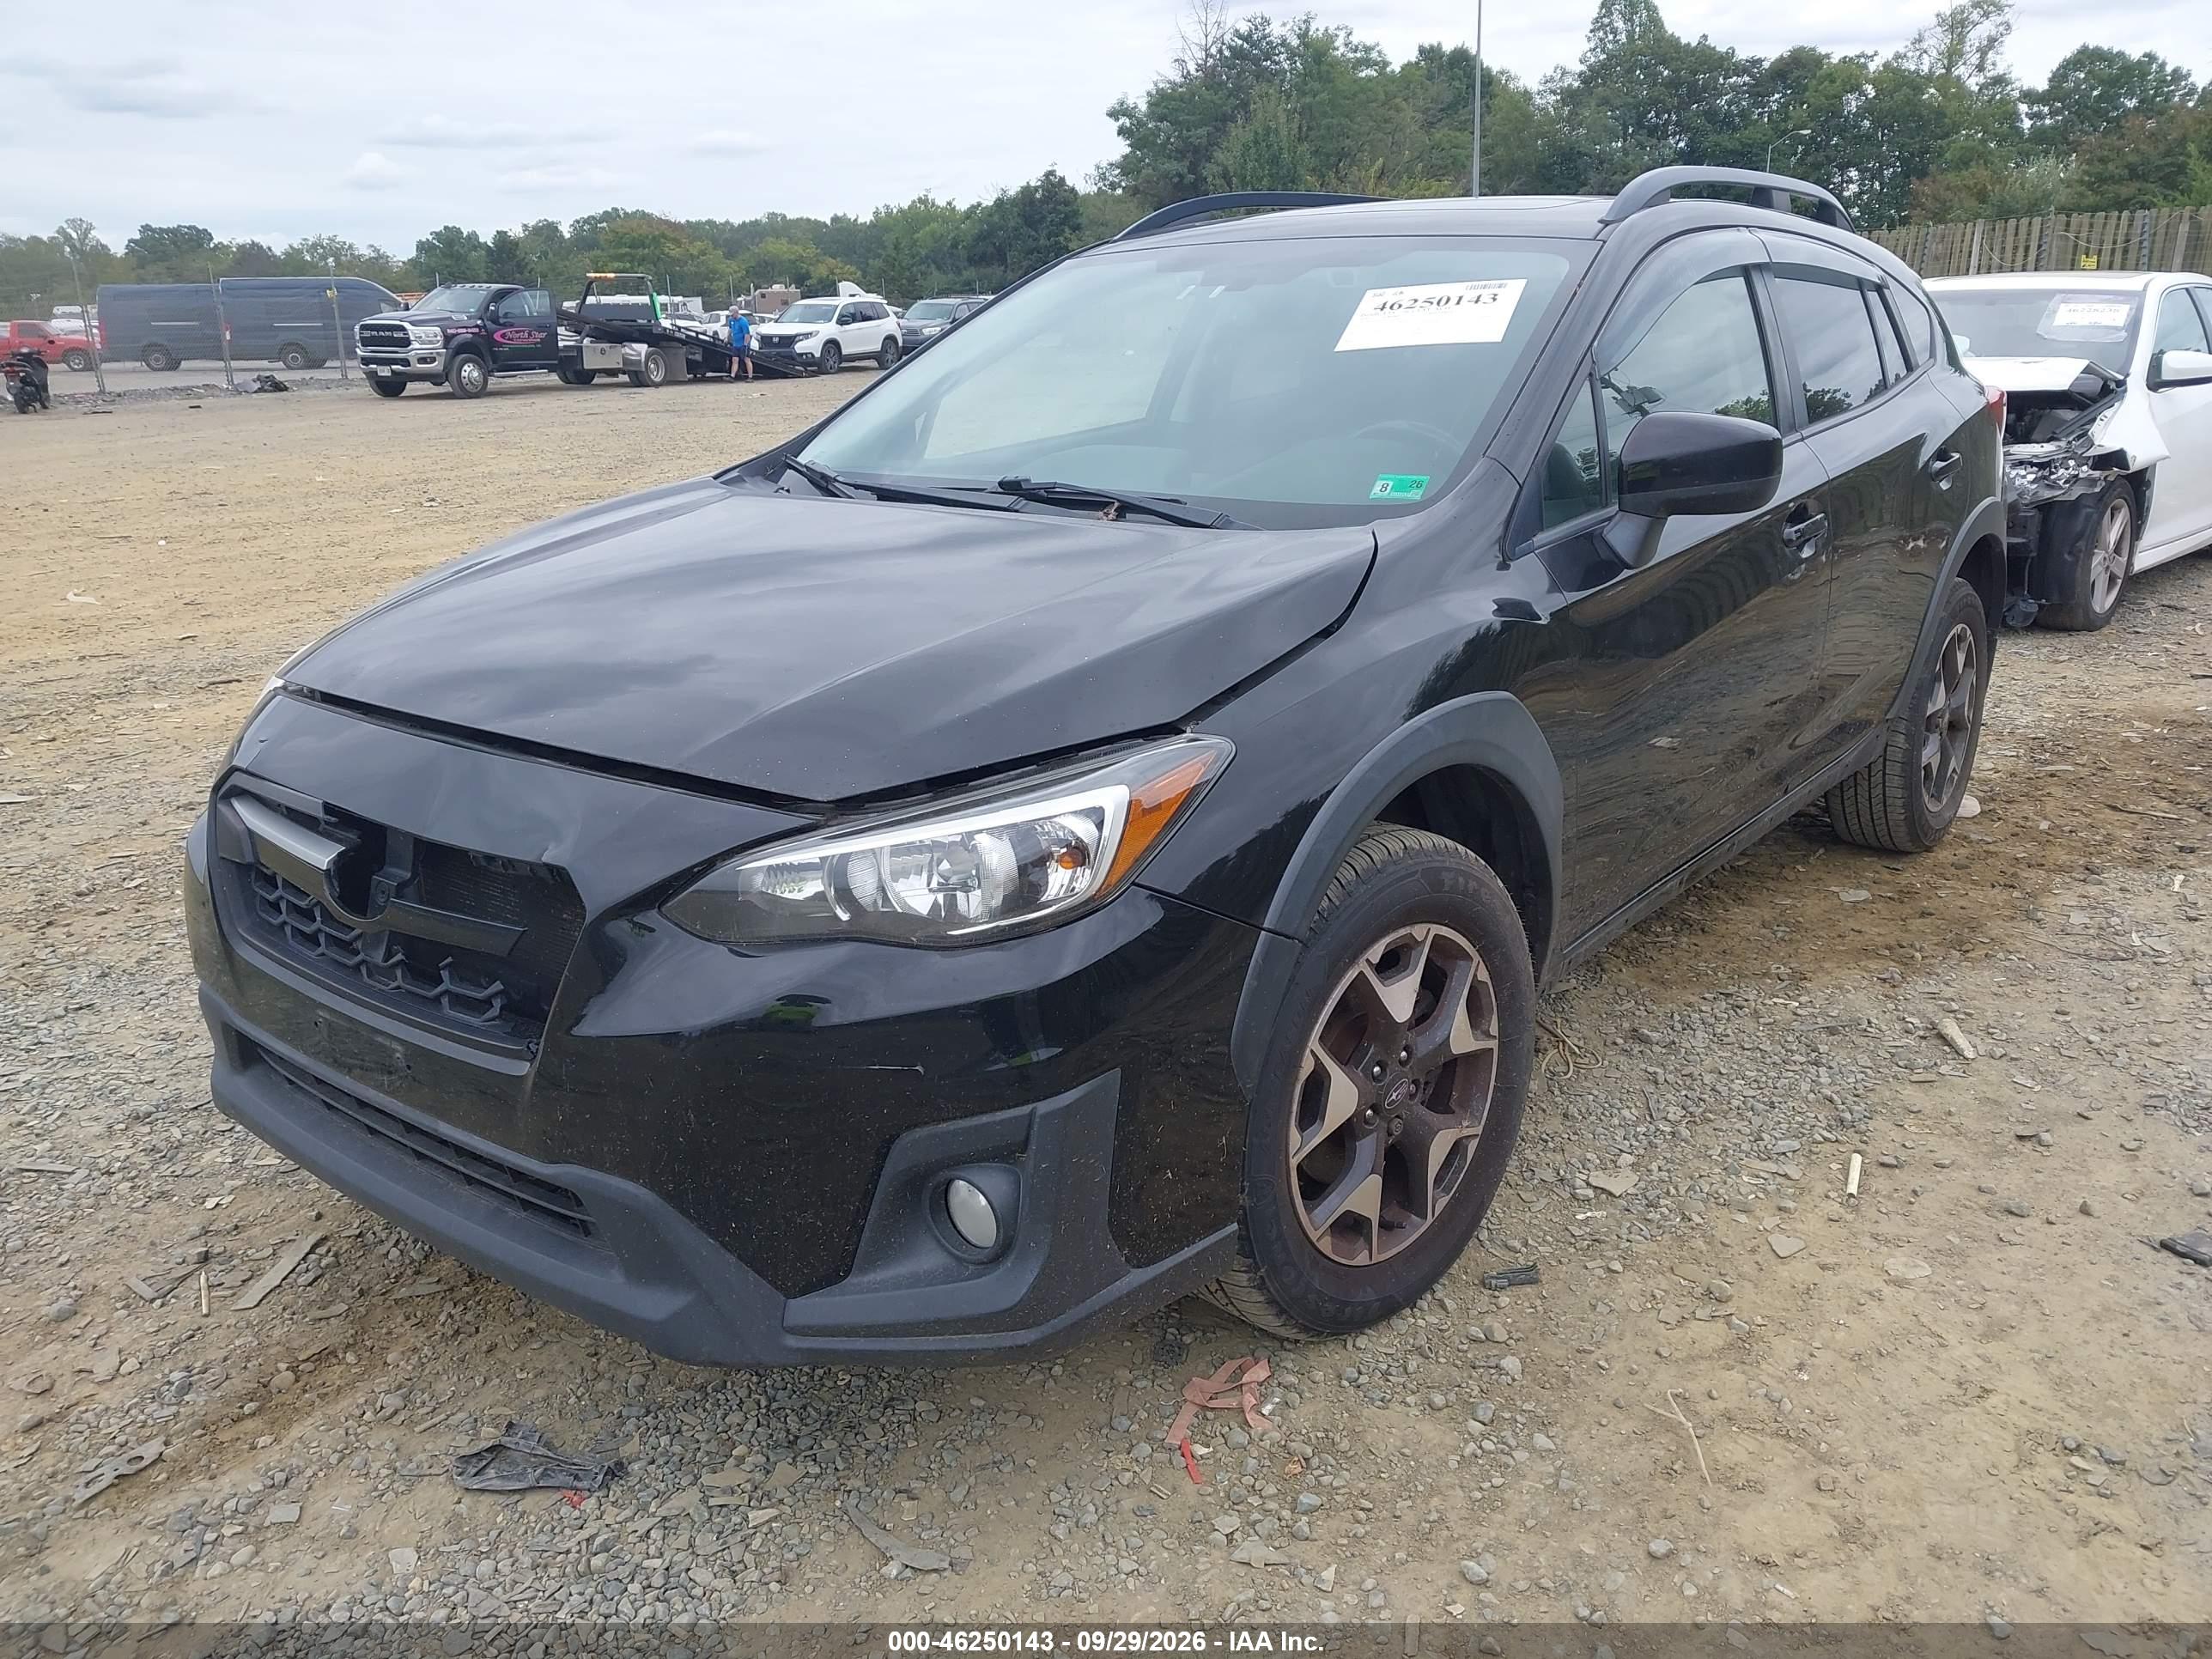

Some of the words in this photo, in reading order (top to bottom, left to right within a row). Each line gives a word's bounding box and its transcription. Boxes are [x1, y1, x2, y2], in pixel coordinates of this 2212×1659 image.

[1373, 293, 1499, 312] 46250143
[504, 330, 528, 339] North
[529, 331, 548, 339] Star
[1379, 483, 1389, 493] 8
[1409, 480, 1424, 489] 26
